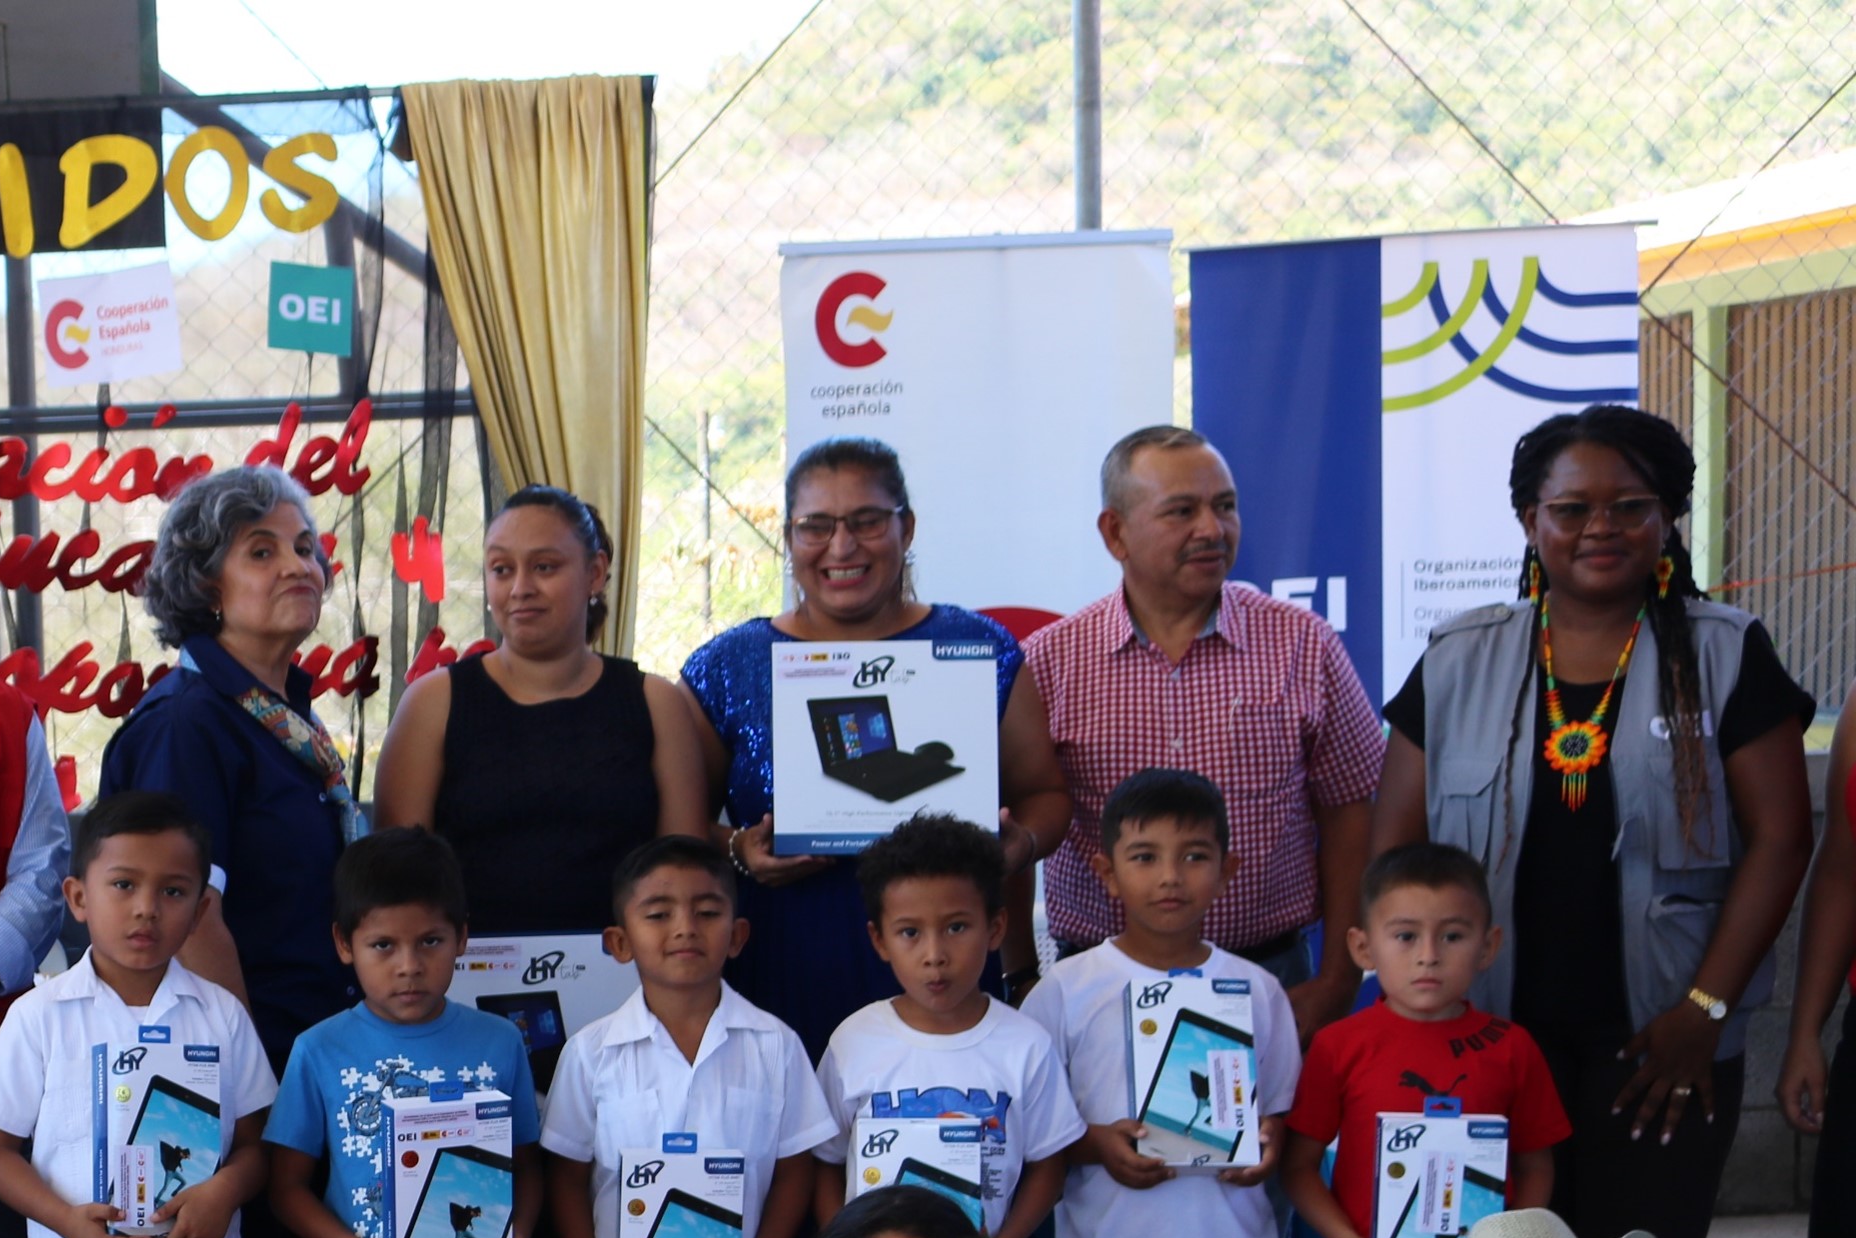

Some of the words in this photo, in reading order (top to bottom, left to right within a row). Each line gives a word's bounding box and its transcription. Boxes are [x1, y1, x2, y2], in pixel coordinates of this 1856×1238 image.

[96, 295, 169, 321] Cooperación
[278, 293, 342, 326] OEI
[99, 319, 151, 341] Española
[810, 379, 904, 400] cooperación
[821, 400, 892, 420] española
[246, 398, 373, 497] del
[1414, 558, 1523, 575] Organización
[936, 645, 993, 657] HYUNDAI
[478, 1106, 509, 1114] HYUNDAI
[397, 1133, 417, 1142] OEI
[709, 1162, 740, 1170] HYUNDAI
[137, 1207, 145, 1227] OEI
